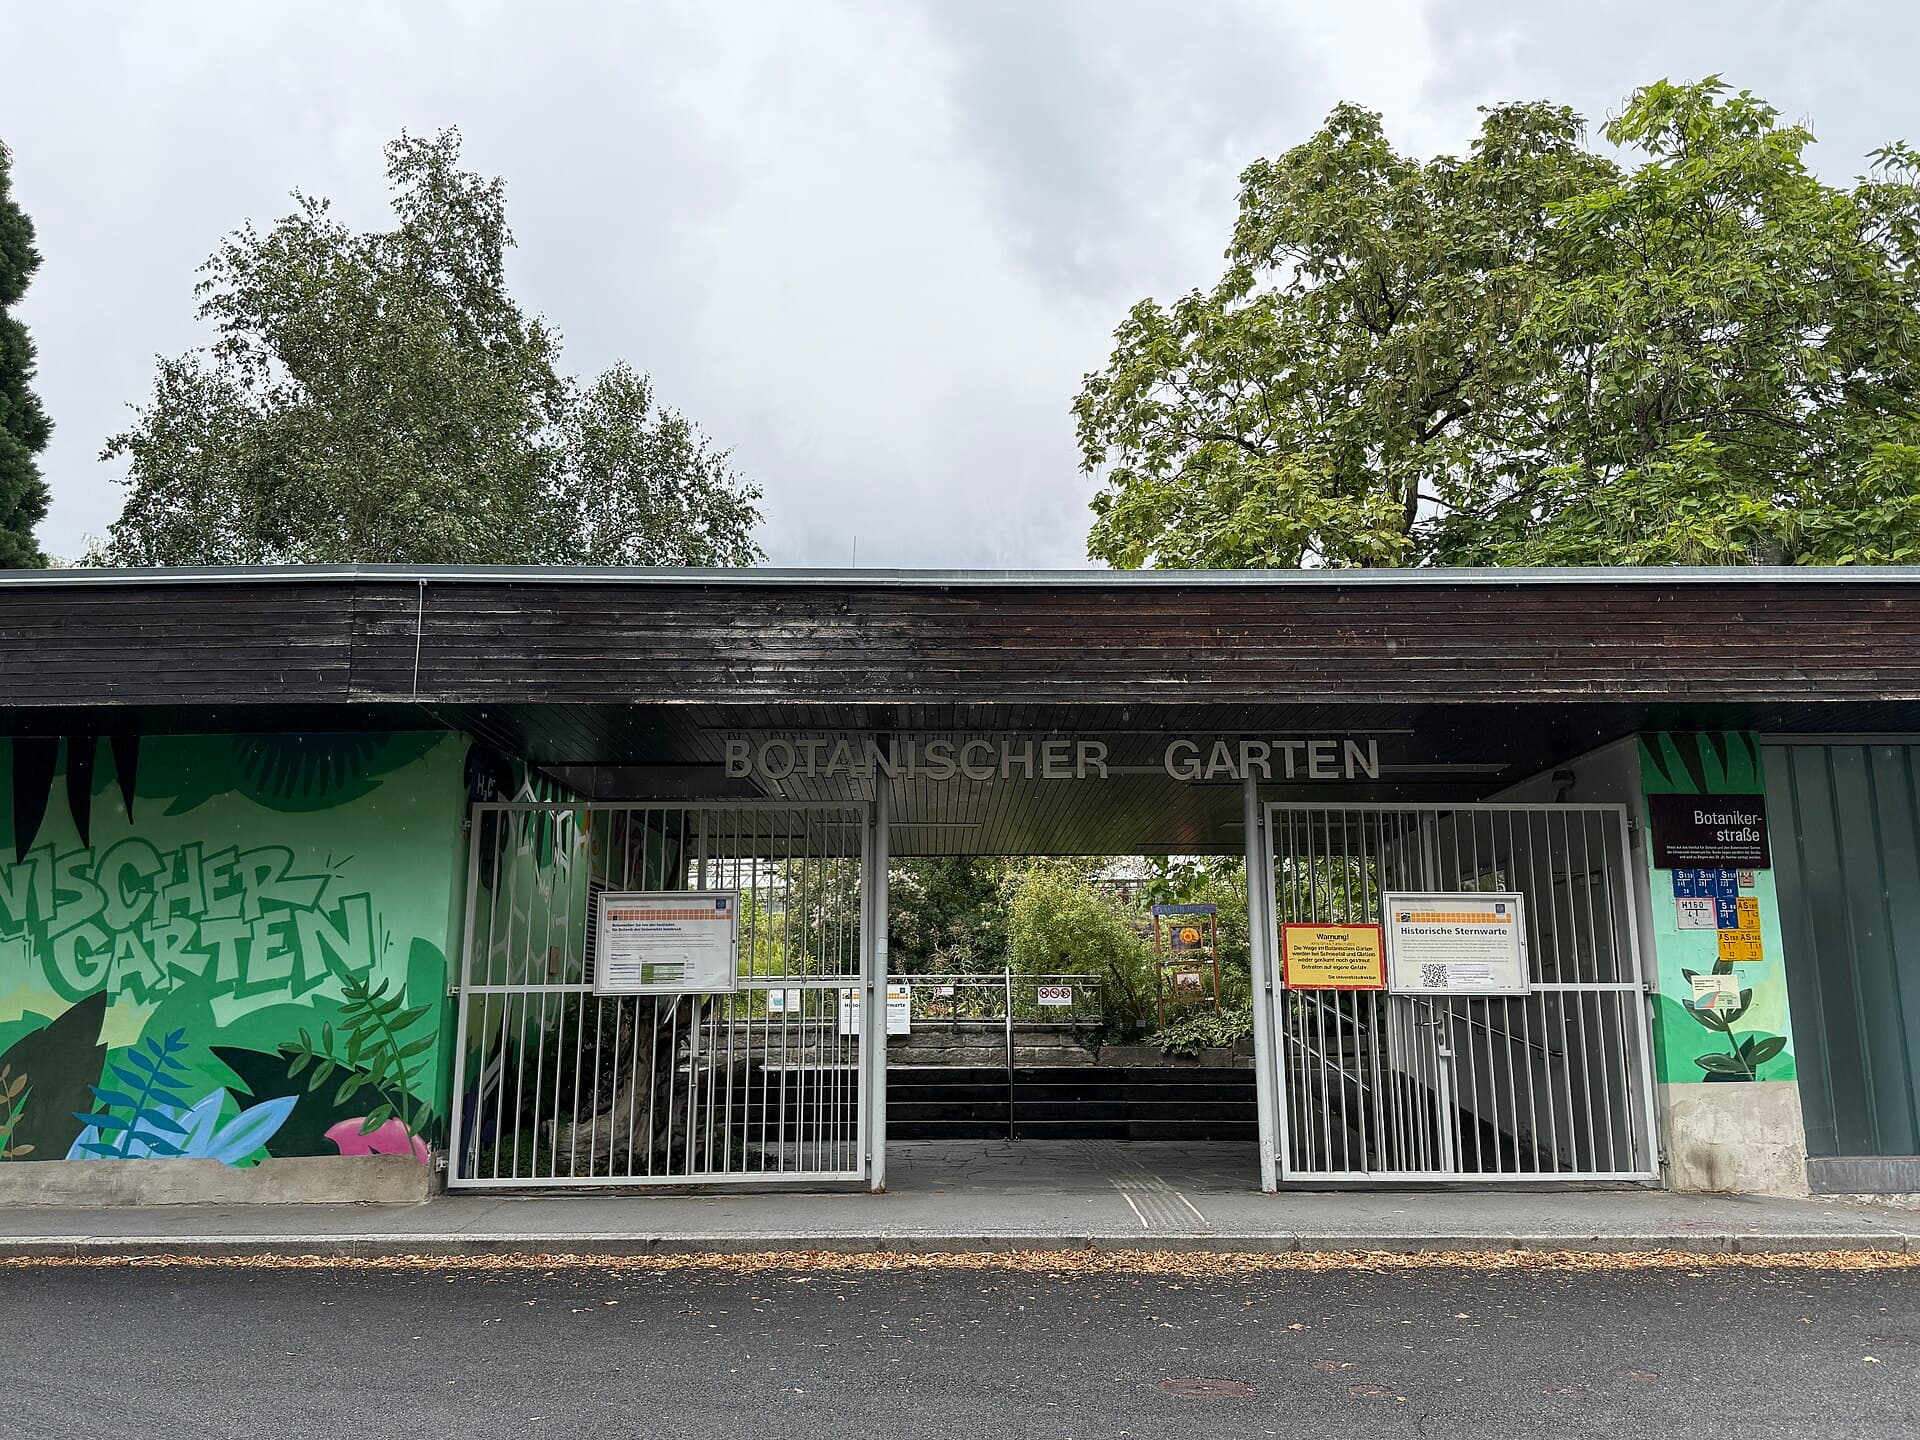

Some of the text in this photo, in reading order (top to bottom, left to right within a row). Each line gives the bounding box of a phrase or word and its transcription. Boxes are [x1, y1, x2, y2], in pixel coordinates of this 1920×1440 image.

[725, 739, 1380, 780] BOTANISCHER GARTEN
[1694, 810, 1762, 825] Botaniker-
[1716, 827, 1760, 842] straße
[1316, 933, 1349, 941] Warnung!
[1401, 927, 1507, 935] Historische Sternwarte
[53, 891, 375, 995] GARTEN
